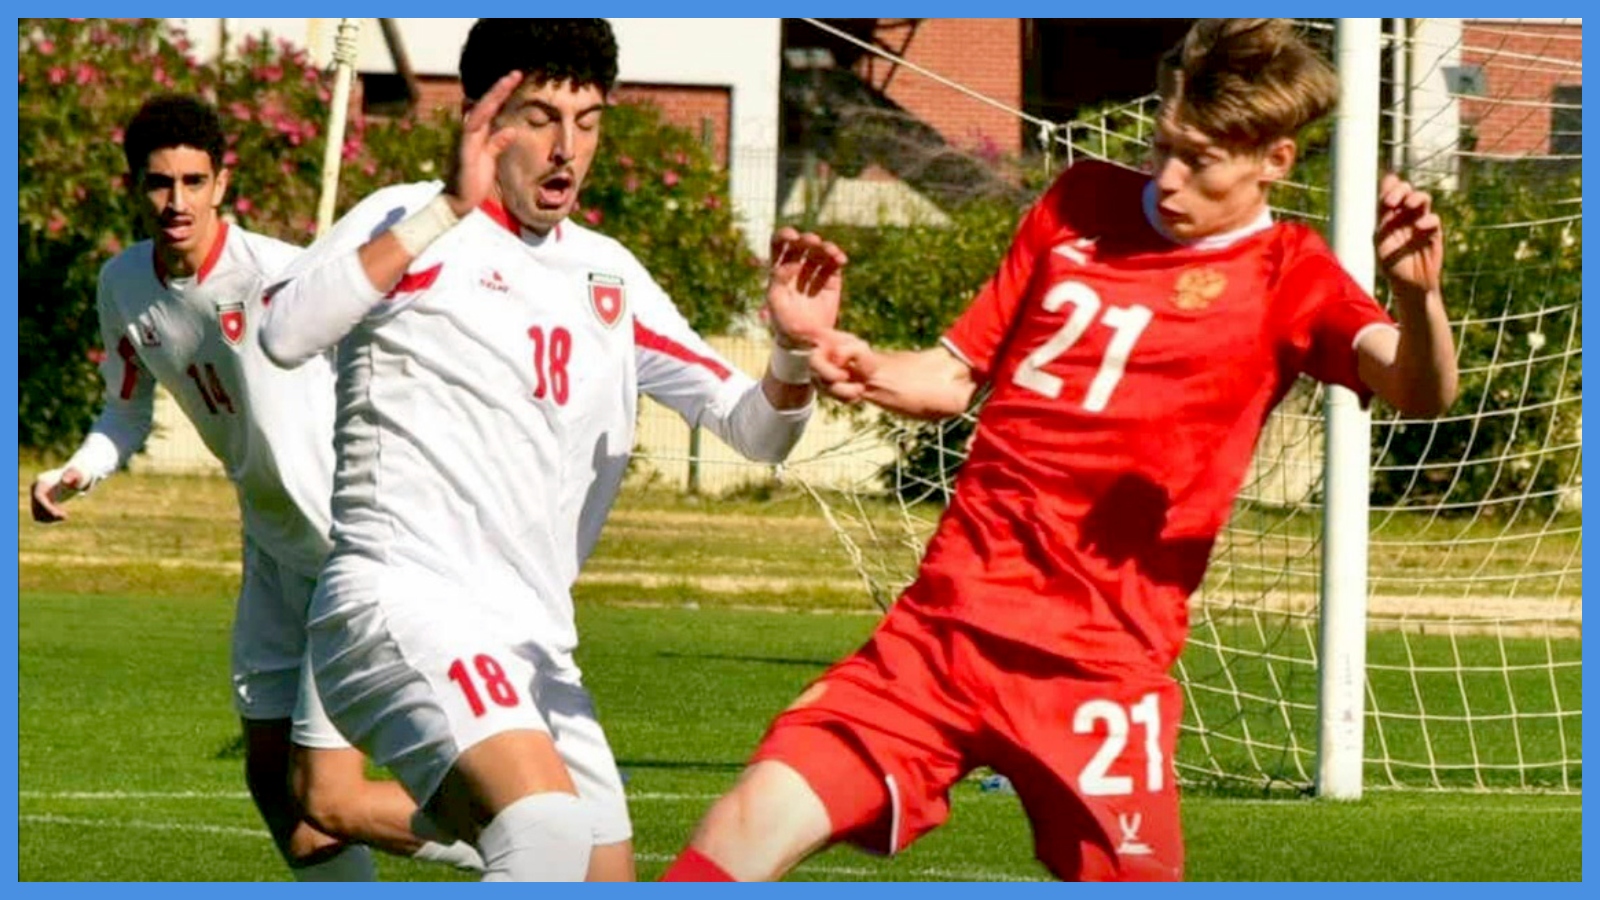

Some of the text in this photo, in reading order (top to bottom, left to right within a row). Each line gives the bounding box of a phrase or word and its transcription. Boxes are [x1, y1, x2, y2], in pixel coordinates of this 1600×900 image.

[528, 325, 571, 406] 18
[1011, 280, 1153, 412] 21
[187, 362, 235, 414] 14
[448, 653, 519, 717] 18
[1073, 693, 1163, 795] 21
